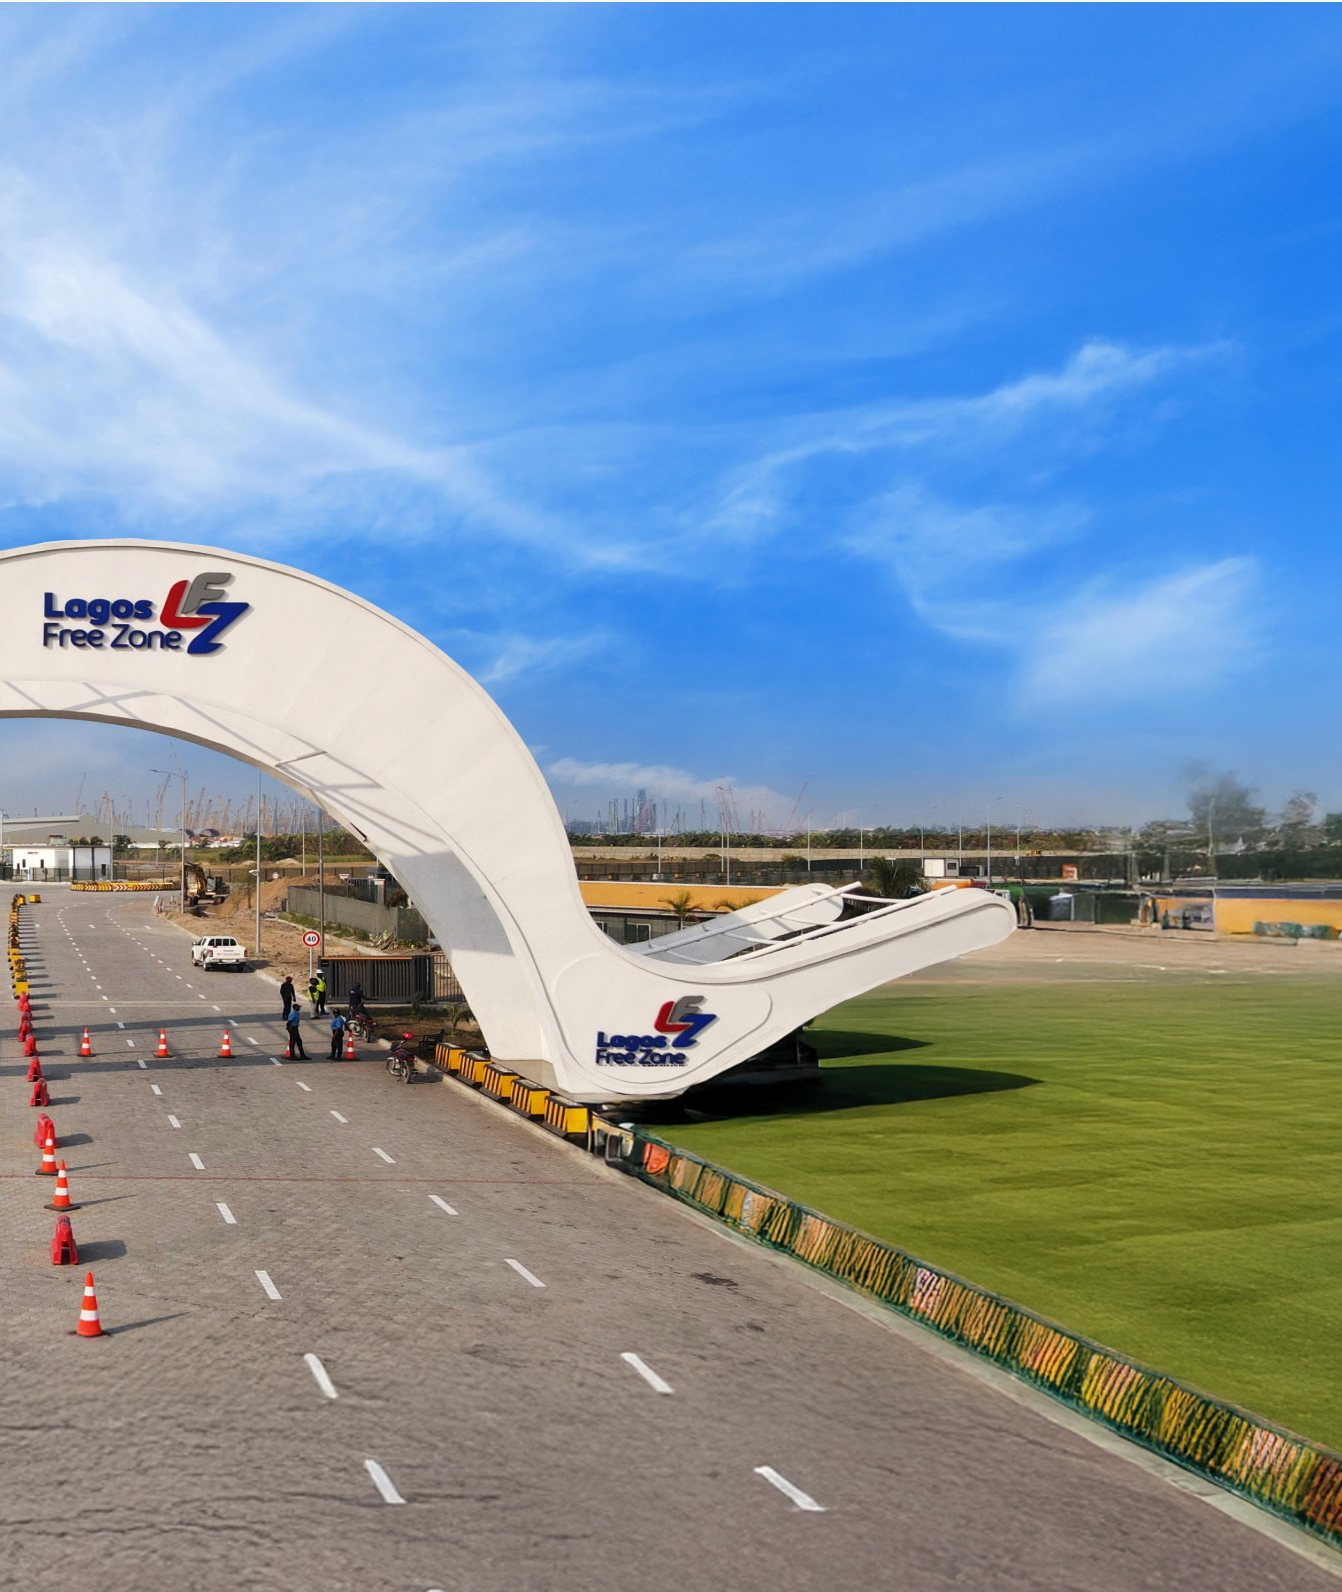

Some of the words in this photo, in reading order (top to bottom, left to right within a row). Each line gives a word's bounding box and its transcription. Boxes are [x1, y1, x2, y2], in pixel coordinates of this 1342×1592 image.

[44, 592, 153, 625] Lagos
[160, 572, 249, 654] LFZ
[43, 622, 104, 647] Free
[110, 624, 182, 649] Zone
[654, 995, 717, 1047] LFZ
[596, 1048, 636, 1064] Free
[638, 1049, 687, 1064] Zone
[597, 1031, 667, 1052] Lagos
